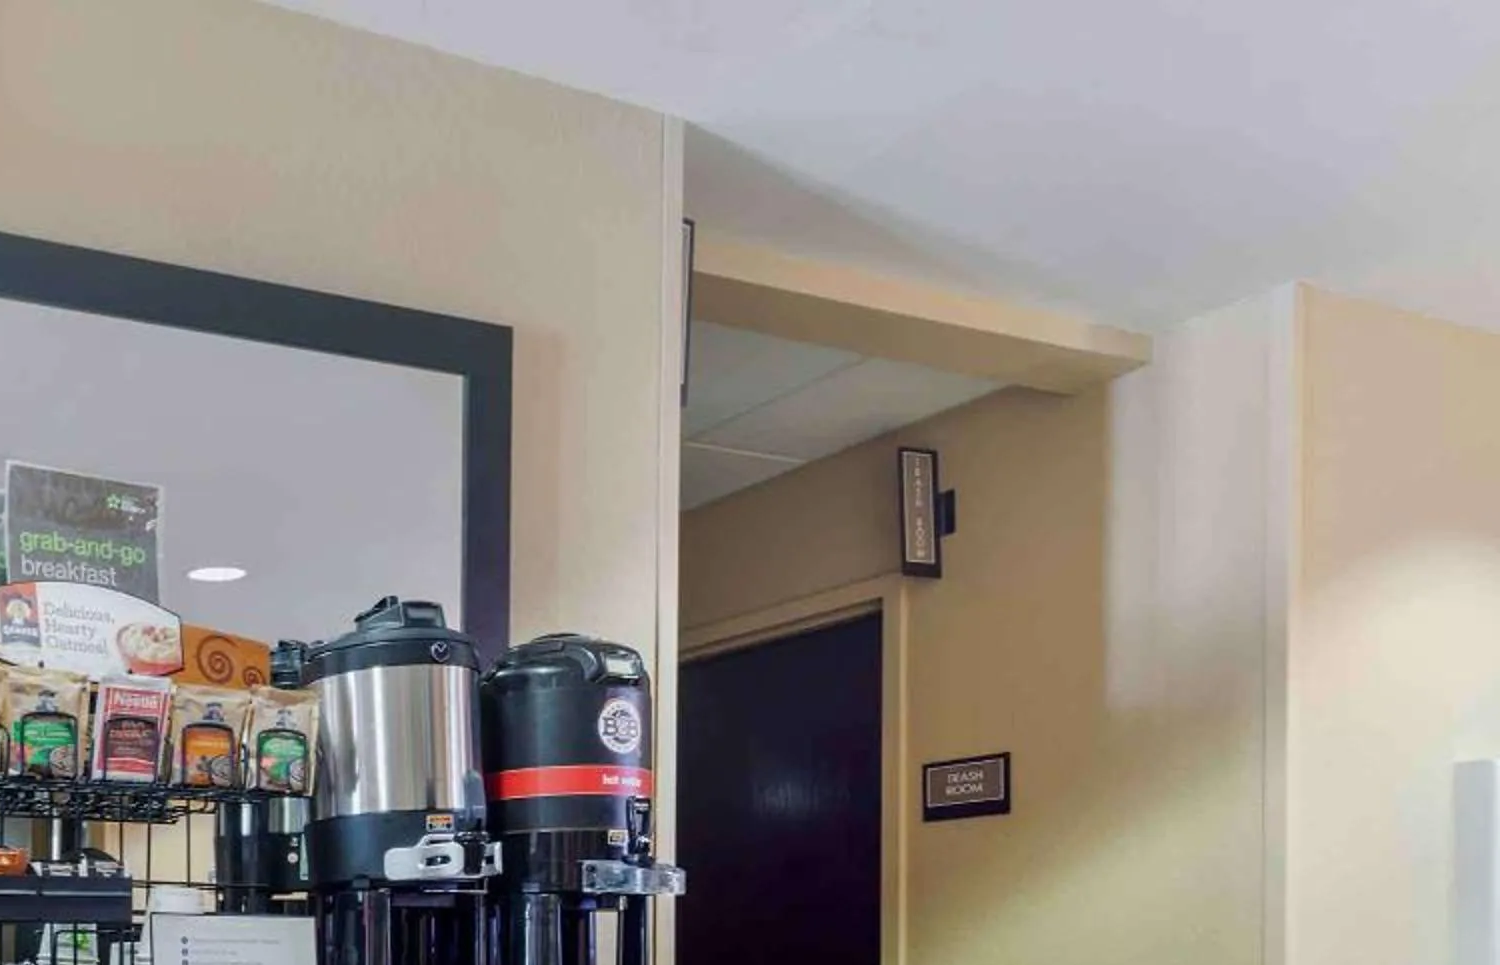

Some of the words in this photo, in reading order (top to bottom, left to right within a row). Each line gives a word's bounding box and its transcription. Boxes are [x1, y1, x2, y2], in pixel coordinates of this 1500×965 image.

[19, 531, 146, 566] grab-and-go
[21, 555, 117, 587] breakfast
[45, 618, 96, 638] Hearty
[45, 636, 108, 655] Oatmeal
[602, 773, 619, 785] hot
[947, 769, 984, 784] TRASH
[946, 783, 984, 796] ROOM
